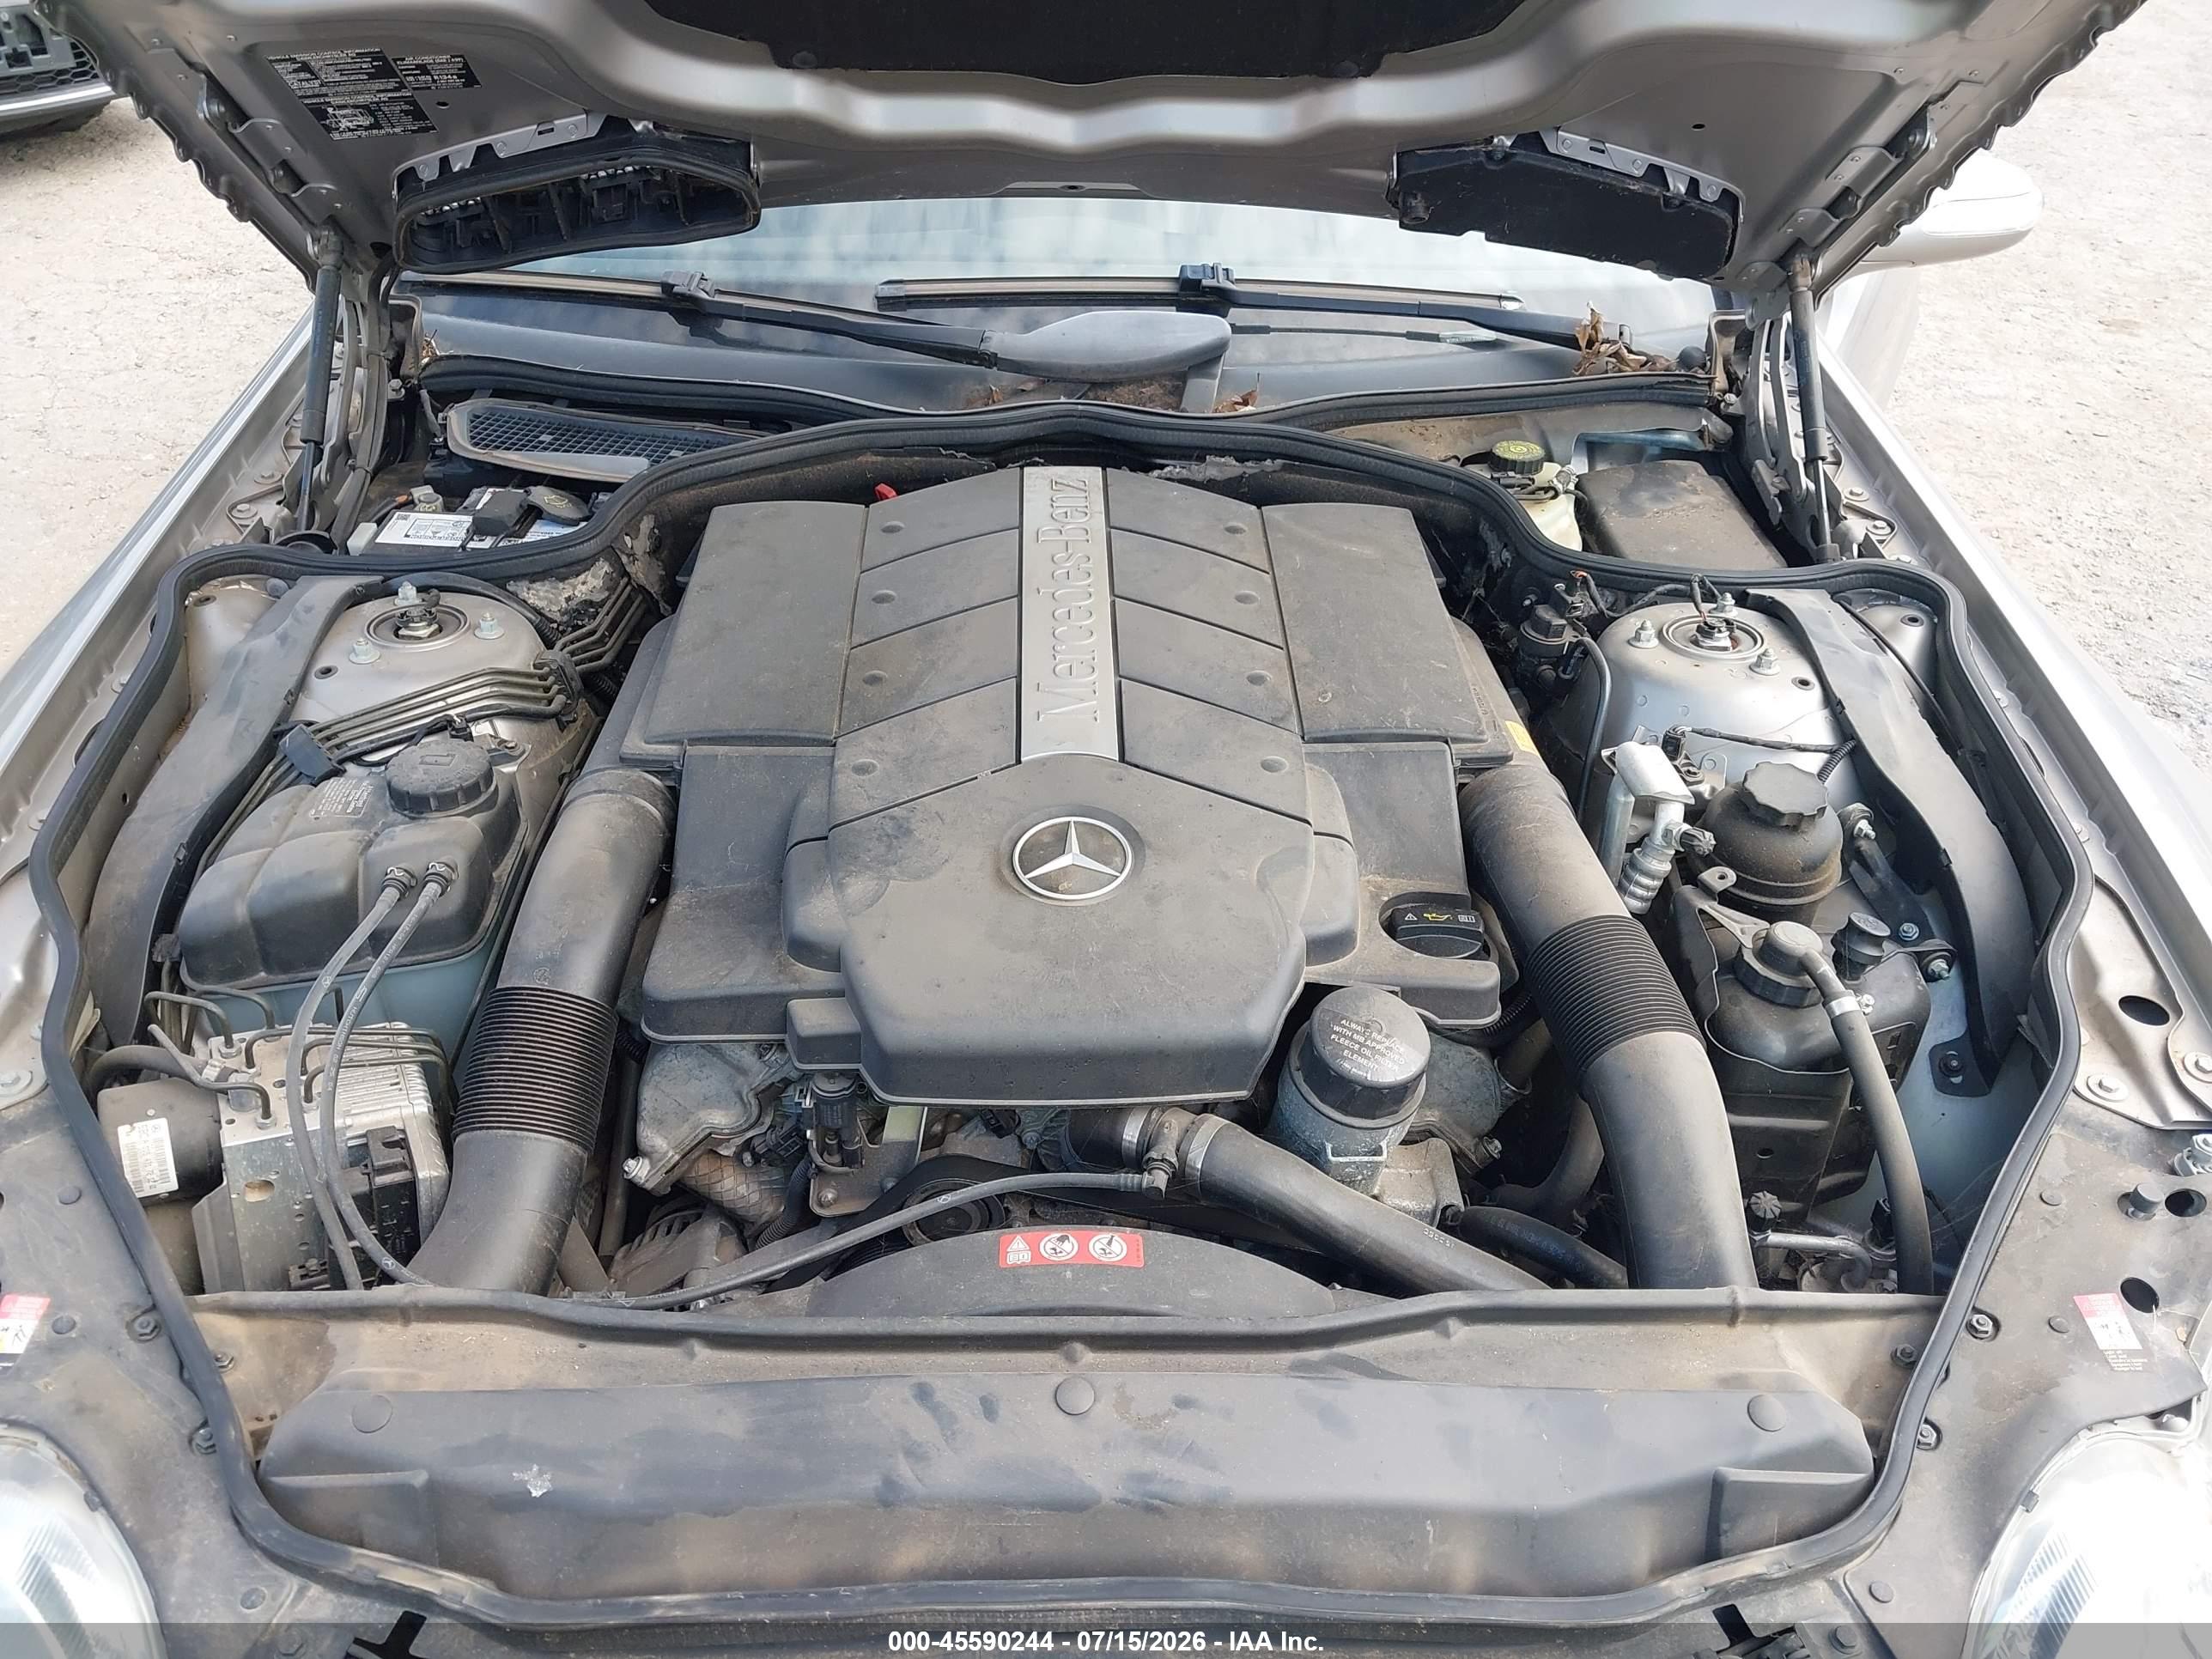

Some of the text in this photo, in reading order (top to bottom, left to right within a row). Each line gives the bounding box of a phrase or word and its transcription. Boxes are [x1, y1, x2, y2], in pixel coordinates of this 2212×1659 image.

[1036, 477, 1100, 724] Mercedes-Benz
[1330, 1034, 1360, 1051] FLEECE
[1361, 1047, 1373, 1058] OIL
[1333, 1024, 1406, 1065] WITH MB APPROVED
[1343, 1049, 1379, 1072] ELEMENT
